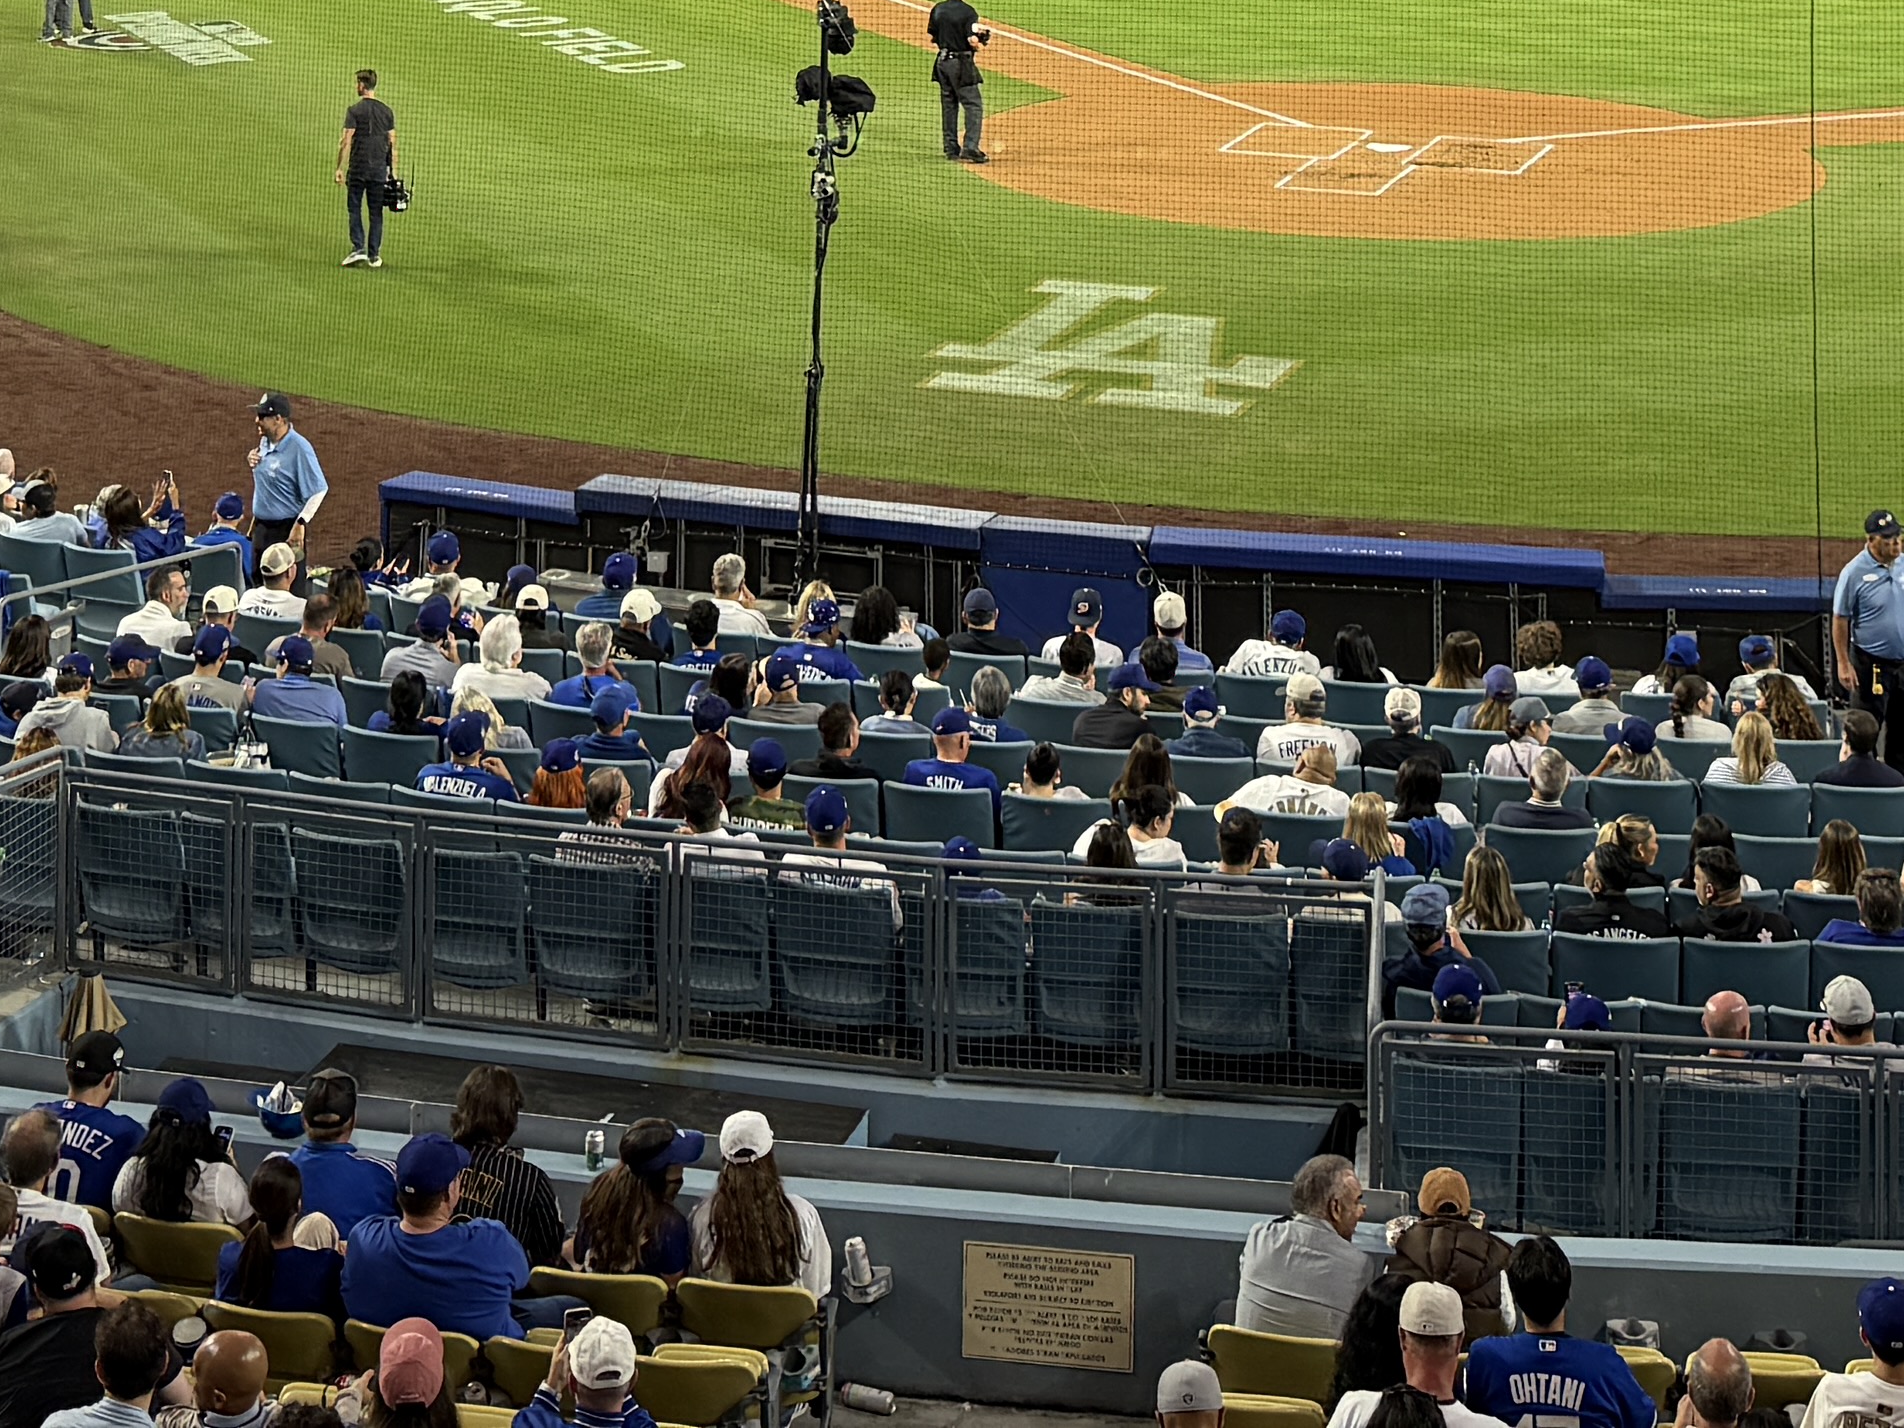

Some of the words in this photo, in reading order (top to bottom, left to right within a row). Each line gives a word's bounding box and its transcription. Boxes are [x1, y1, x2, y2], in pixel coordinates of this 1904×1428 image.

[519, 26, 686, 75] FIELD
[921, 278, 1300, 416] LA
[927, 775, 964, 791] SMITH
[1509, 1372, 1586, 1412] OHTANI
